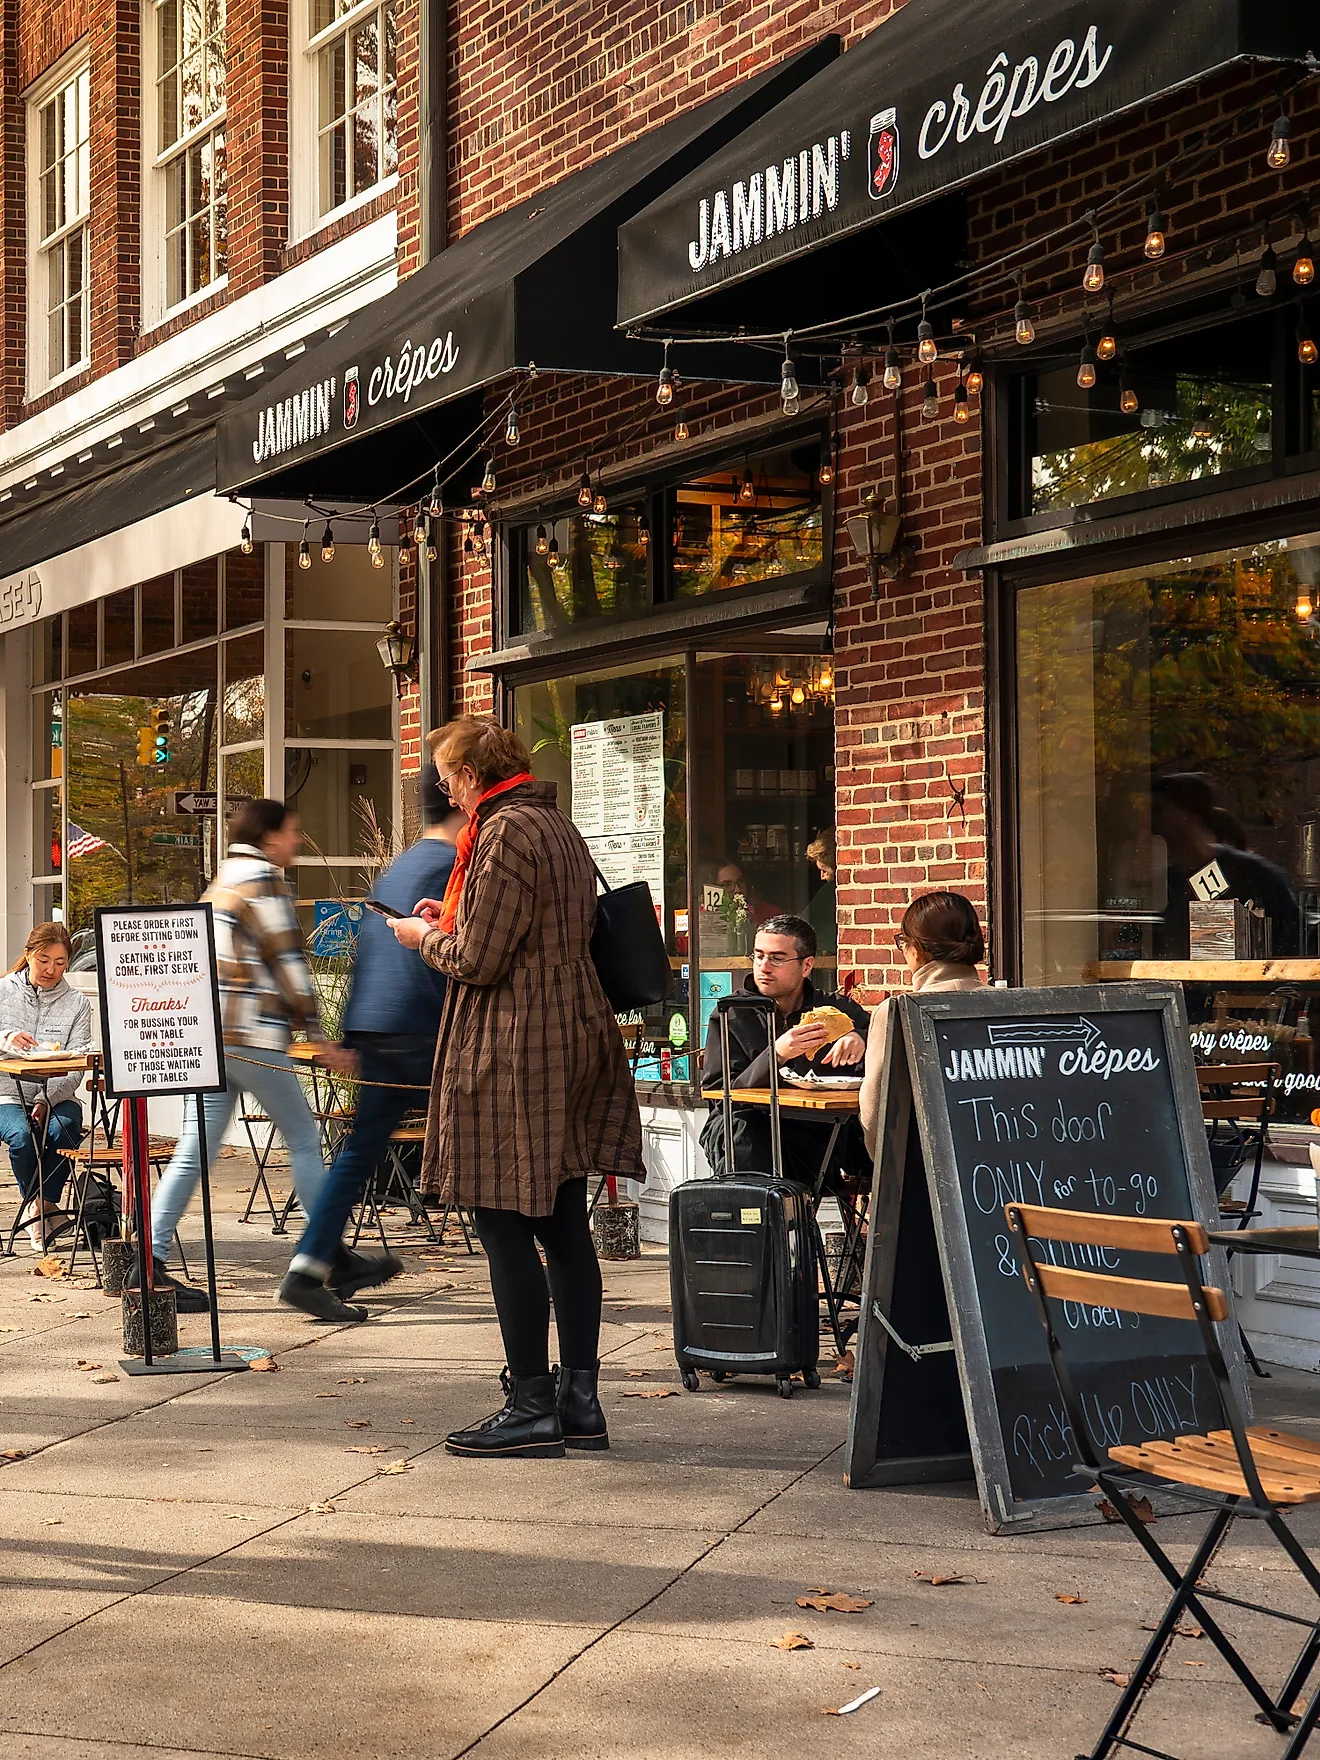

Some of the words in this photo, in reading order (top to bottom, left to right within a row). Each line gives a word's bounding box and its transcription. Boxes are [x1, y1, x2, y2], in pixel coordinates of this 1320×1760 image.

[688, 130, 851, 272] JAMMIN'
[917, 24, 1112, 160] crêpes
[252, 376, 337, 464] JAMMIN'
[367, 330, 460, 407] crêpes
[1198, 868, 1221, 895] 11
[706, 890, 721, 908] 12
[113, 920, 141, 930] PLEASE
[143, 919, 170, 929] ORDER
[171, 918, 194, 928] FIRST
[111, 932, 140, 942] BEFORE
[142, 931, 172, 941] SITTING
[175, 930, 198, 940] DOWN
[120, 952, 155, 963] SEATING
[157, 952, 166, 962] IS
[168, 951, 193, 961] FIRST
[115, 966, 143, 977] COME,
[144, 964, 169, 975] FIRST
[171, 963, 199, 974] SERVE
[131, 996, 189, 1013] Thanks!
[124, 1019, 138, 1029] FOR
[141, 1017, 175, 1028] BUSSING
[177, 1016, 198, 1026] YOUR
[140, 1031, 158, 1041] OWN
[160, 1029, 184, 1039] TABLE
[1189, 1030, 1216, 1056] ory
[1219, 1029, 1271, 1055] crêpes
[124, 1049, 147, 1060] BEING
[149, 1046, 203, 1059] CONSIDERATE
[945, 1046, 1046, 1082] JAMMIN'
[1058, 1041, 1160, 1080] crêpes
[128, 1062, 138, 1072] OF
[140, 1061, 165, 1071] THOSE
[167, 1059, 200, 1070] WAITING
[142, 1073, 158, 1084] FOR
[159, 1071, 188, 1083] TABLES
[957, 1096, 1038, 1142] This
[1051, 1098, 1112, 1143] door
[972, 1159, 1044, 1215] ONLY
[1053, 1175, 1076, 1200] for
[1085, 1168, 1158, 1215] to-go
[994, 1234, 1019, 1277] &
[1013, 1404, 1072, 1478] Pick
[1080, 1392, 1123, 1448] Up
[1131, 1364, 1199, 1437] ONLY
